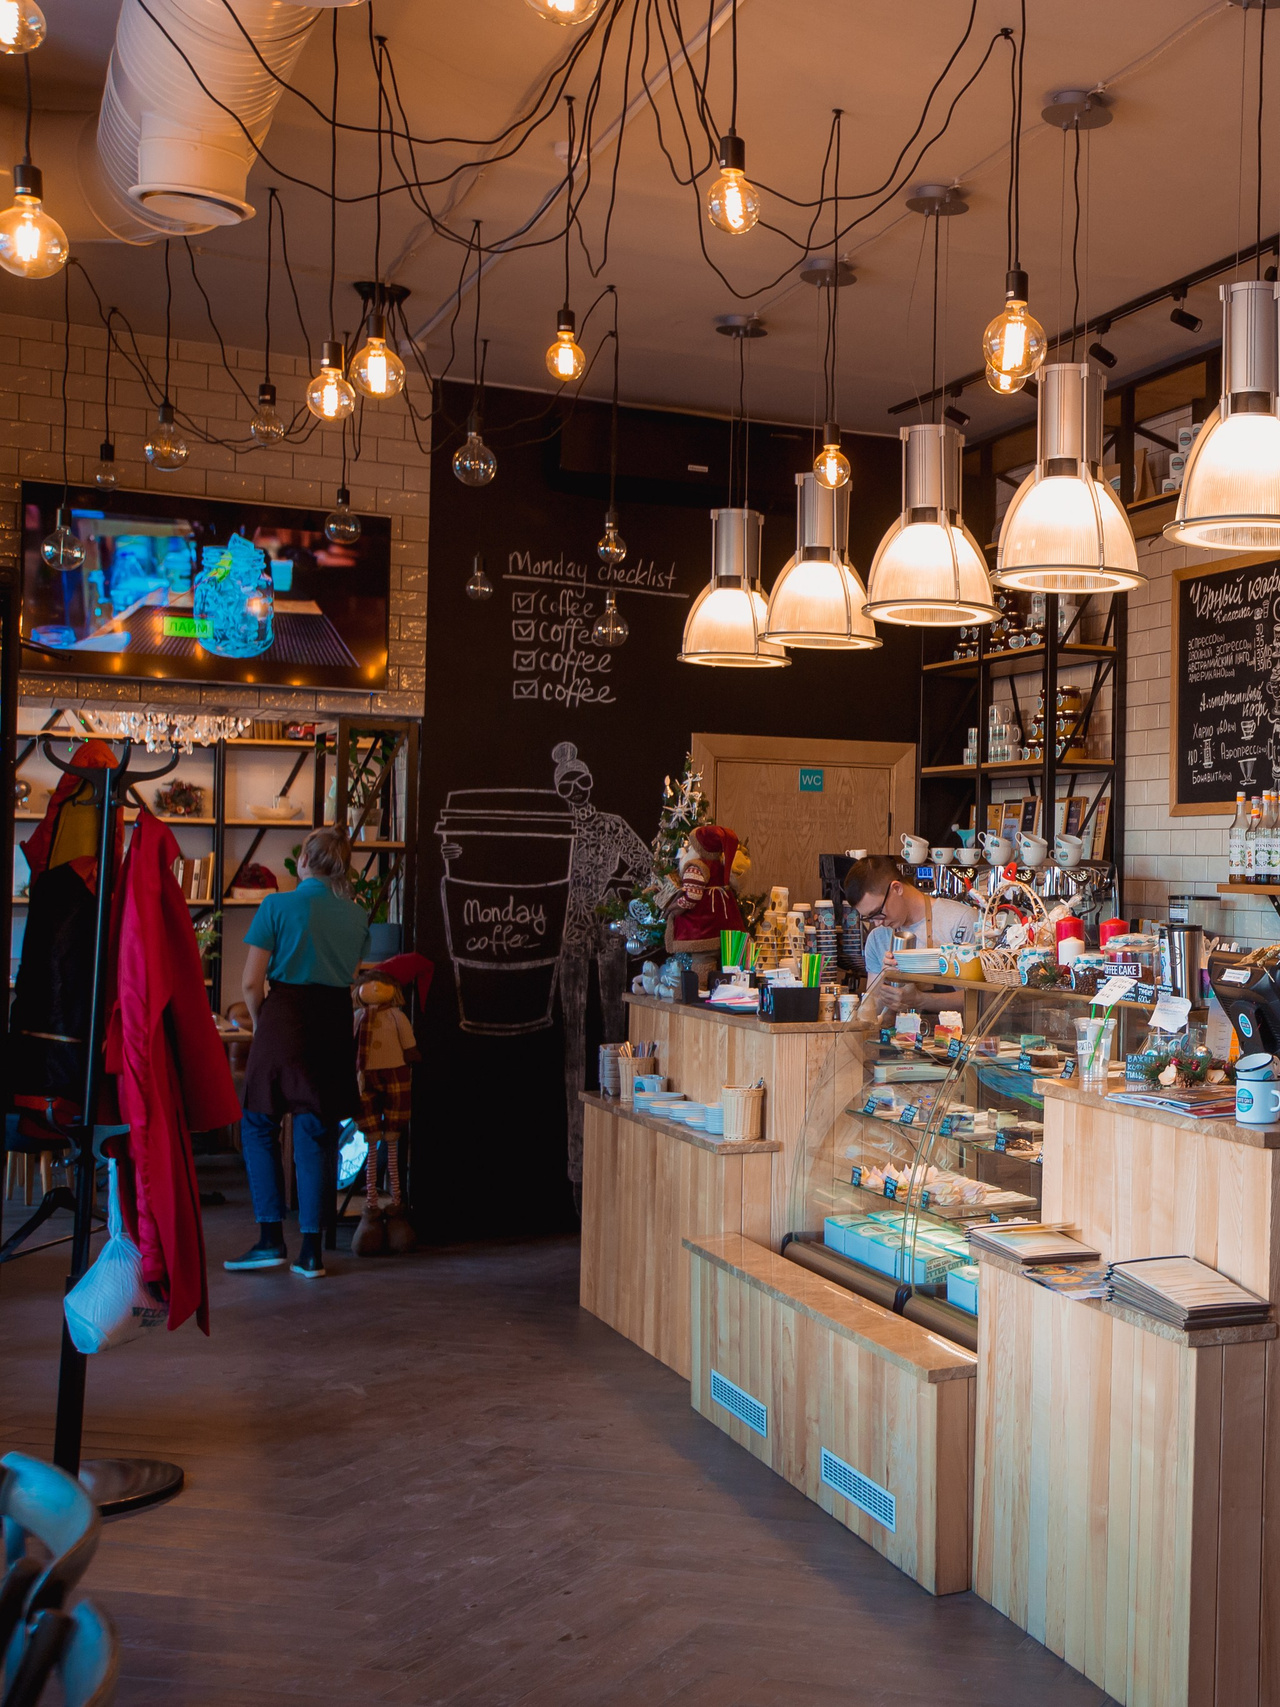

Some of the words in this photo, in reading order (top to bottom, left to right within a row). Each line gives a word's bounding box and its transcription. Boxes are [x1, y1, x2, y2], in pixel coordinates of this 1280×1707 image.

[509, 551, 587, 599] Monday
[598, 559, 677, 590] checklist
[802, 775, 822, 786] WC
[464, 895, 547, 935] Monday
[466, 924, 538, 955] coffee
[1118, 965, 1137, 976] CAKE
